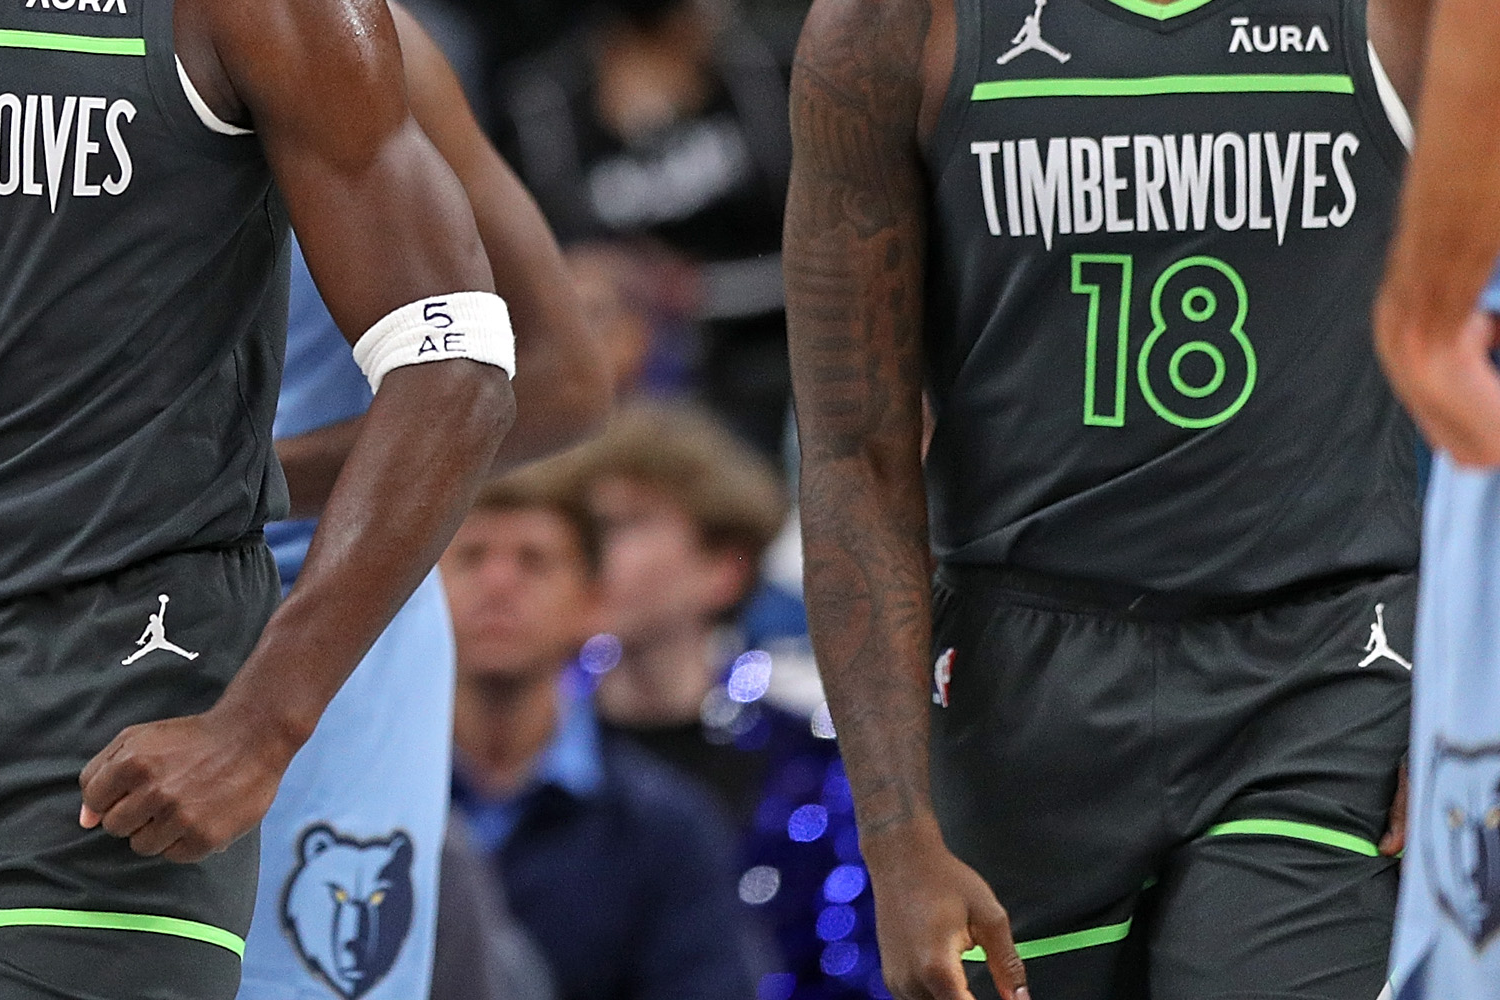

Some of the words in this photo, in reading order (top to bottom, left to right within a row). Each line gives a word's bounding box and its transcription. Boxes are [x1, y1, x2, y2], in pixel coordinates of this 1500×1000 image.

[971, 131, 1360, 251] TIMBERWOLVES
[418, 333, 466, 356] AE
[423, 302, 453, 328] 5
[1071, 254, 1257, 429] 18
